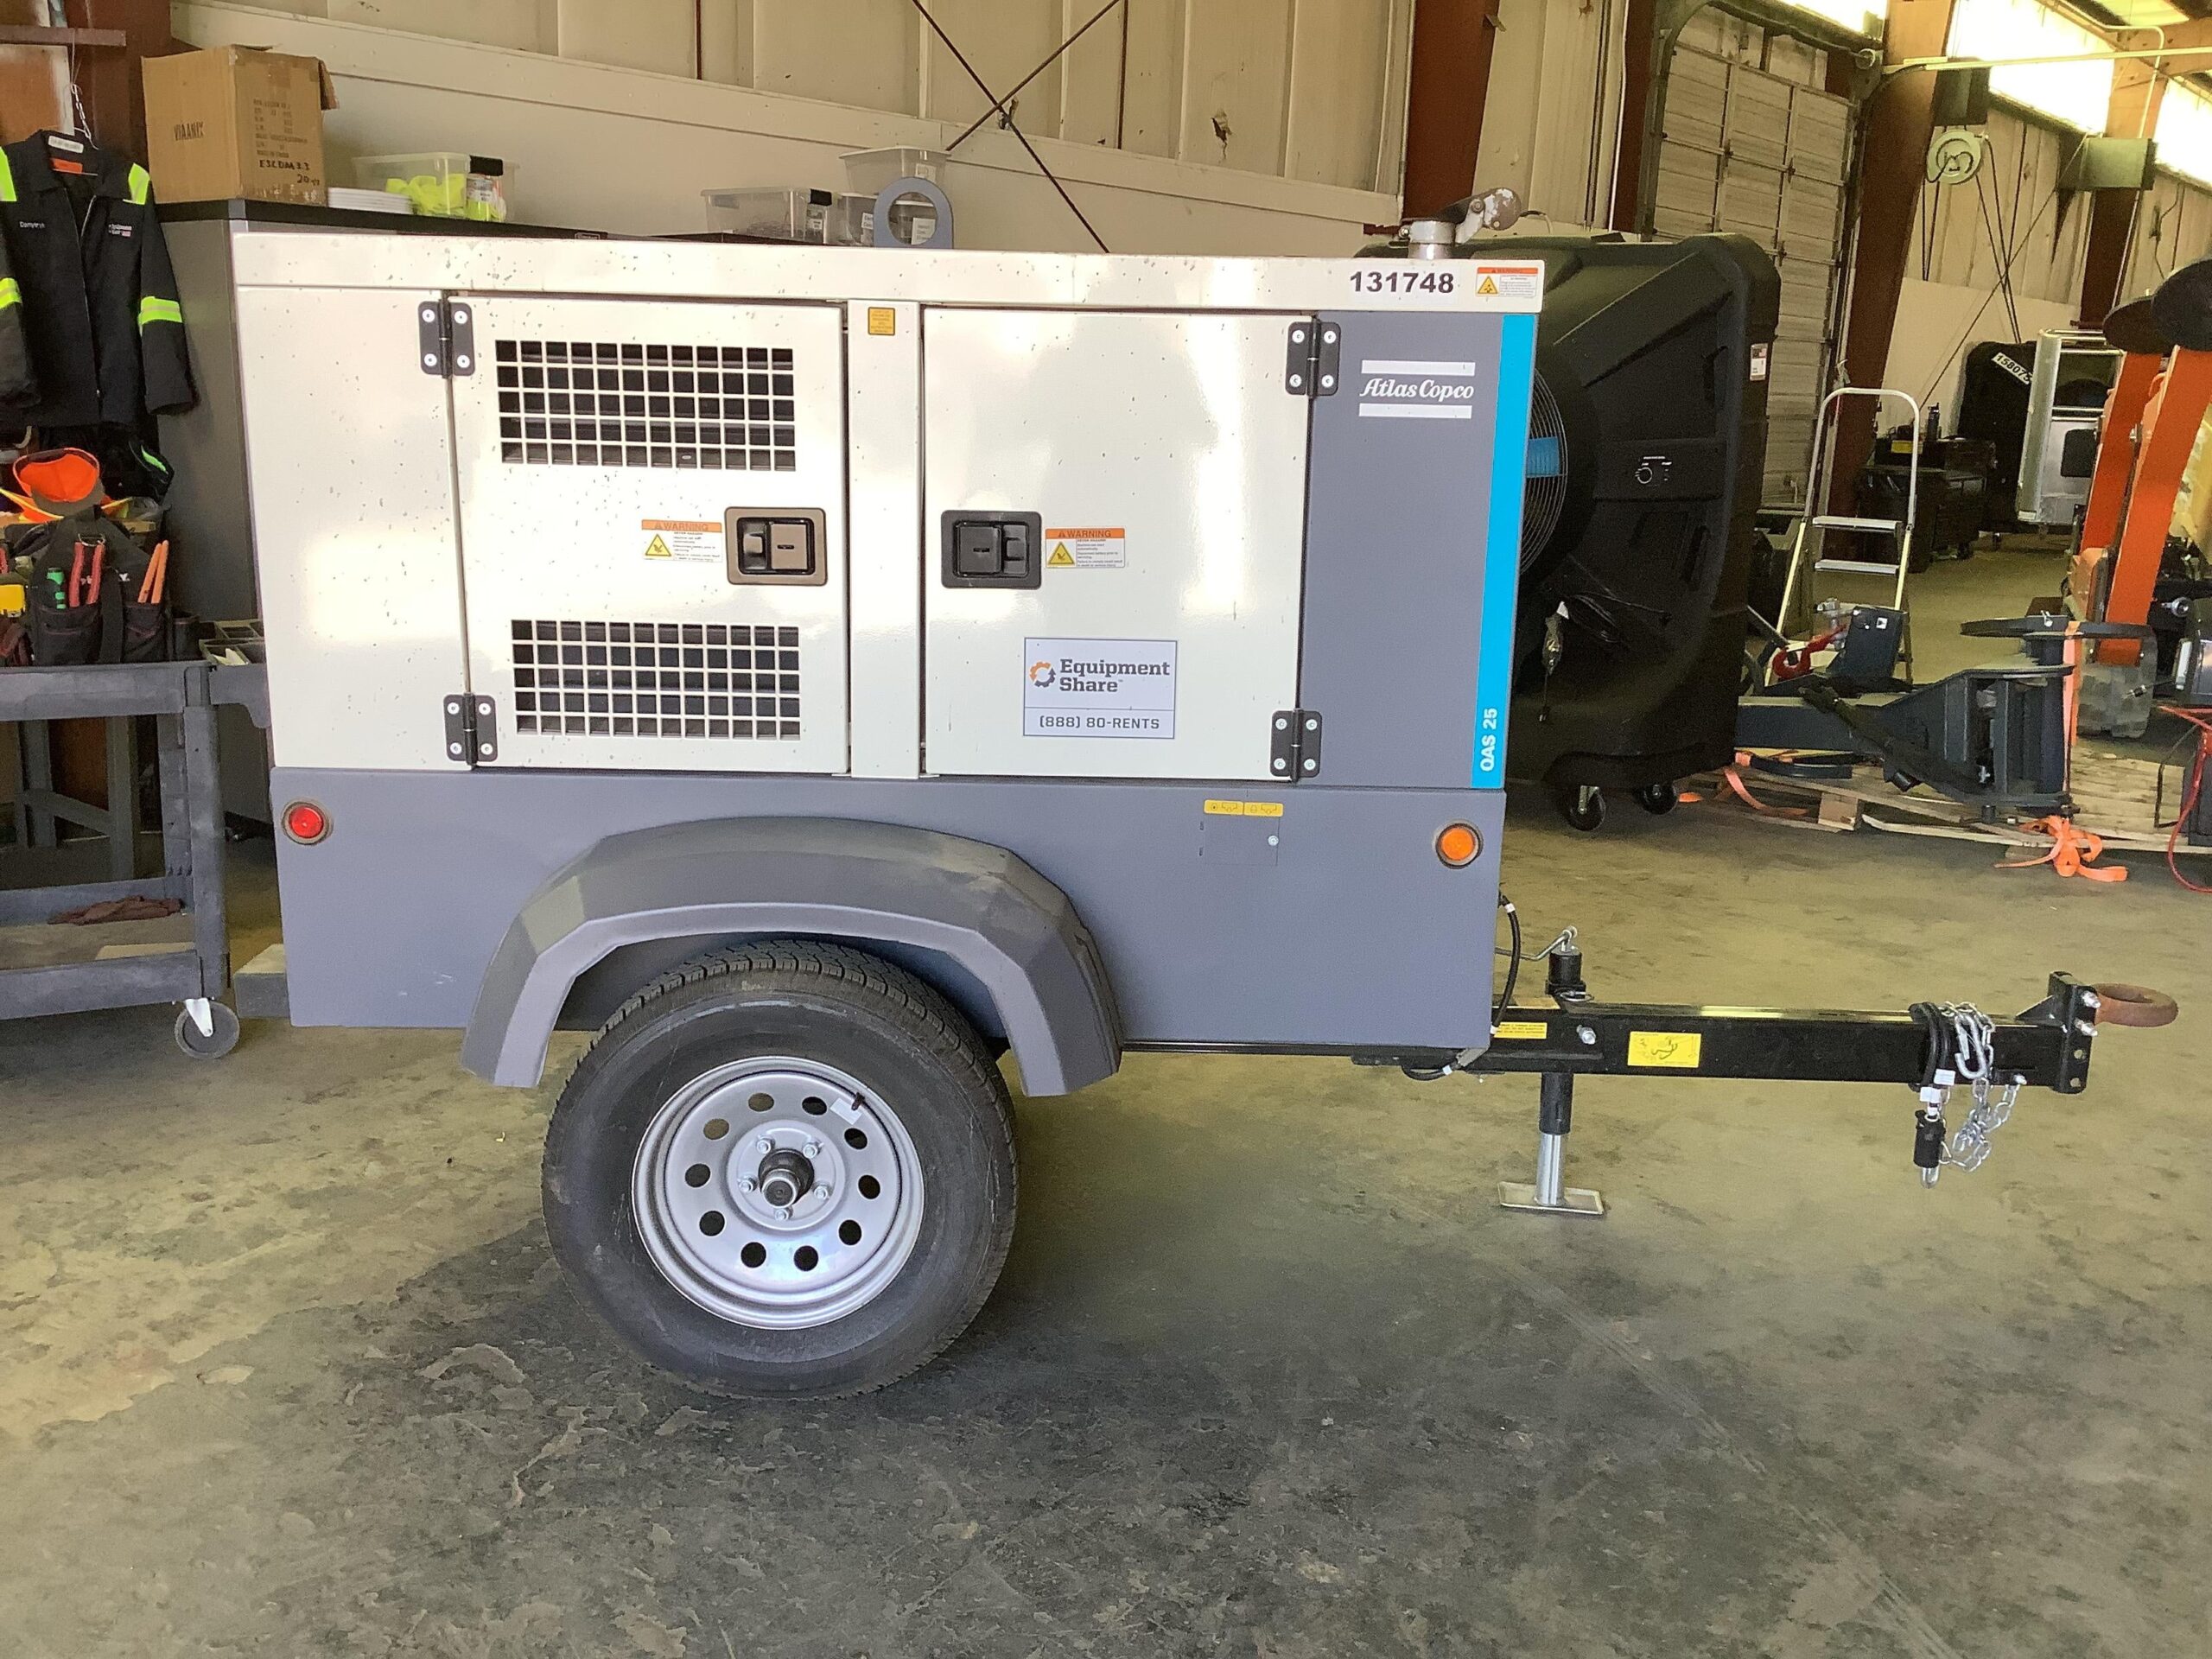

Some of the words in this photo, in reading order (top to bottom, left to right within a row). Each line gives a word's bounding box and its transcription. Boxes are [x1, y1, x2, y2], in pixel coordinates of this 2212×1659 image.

[1350, 271, 1453, 294] 131748
[1359, 378, 1417, 398] Atlas
[1419, 379, 1474, 402] Copco
[663, 522, 709, 531] WARNING
[1067, 530, 1112, 538] WARNING
[1059, 658, 1170, 677] Equipment
[1059, 677, 1118, 692] Share
[1039, 715, 1081, 728] (888)
[1086, 717, 1160, 729] 80-RENTS
[1483, 708, 1498, 730] 25
